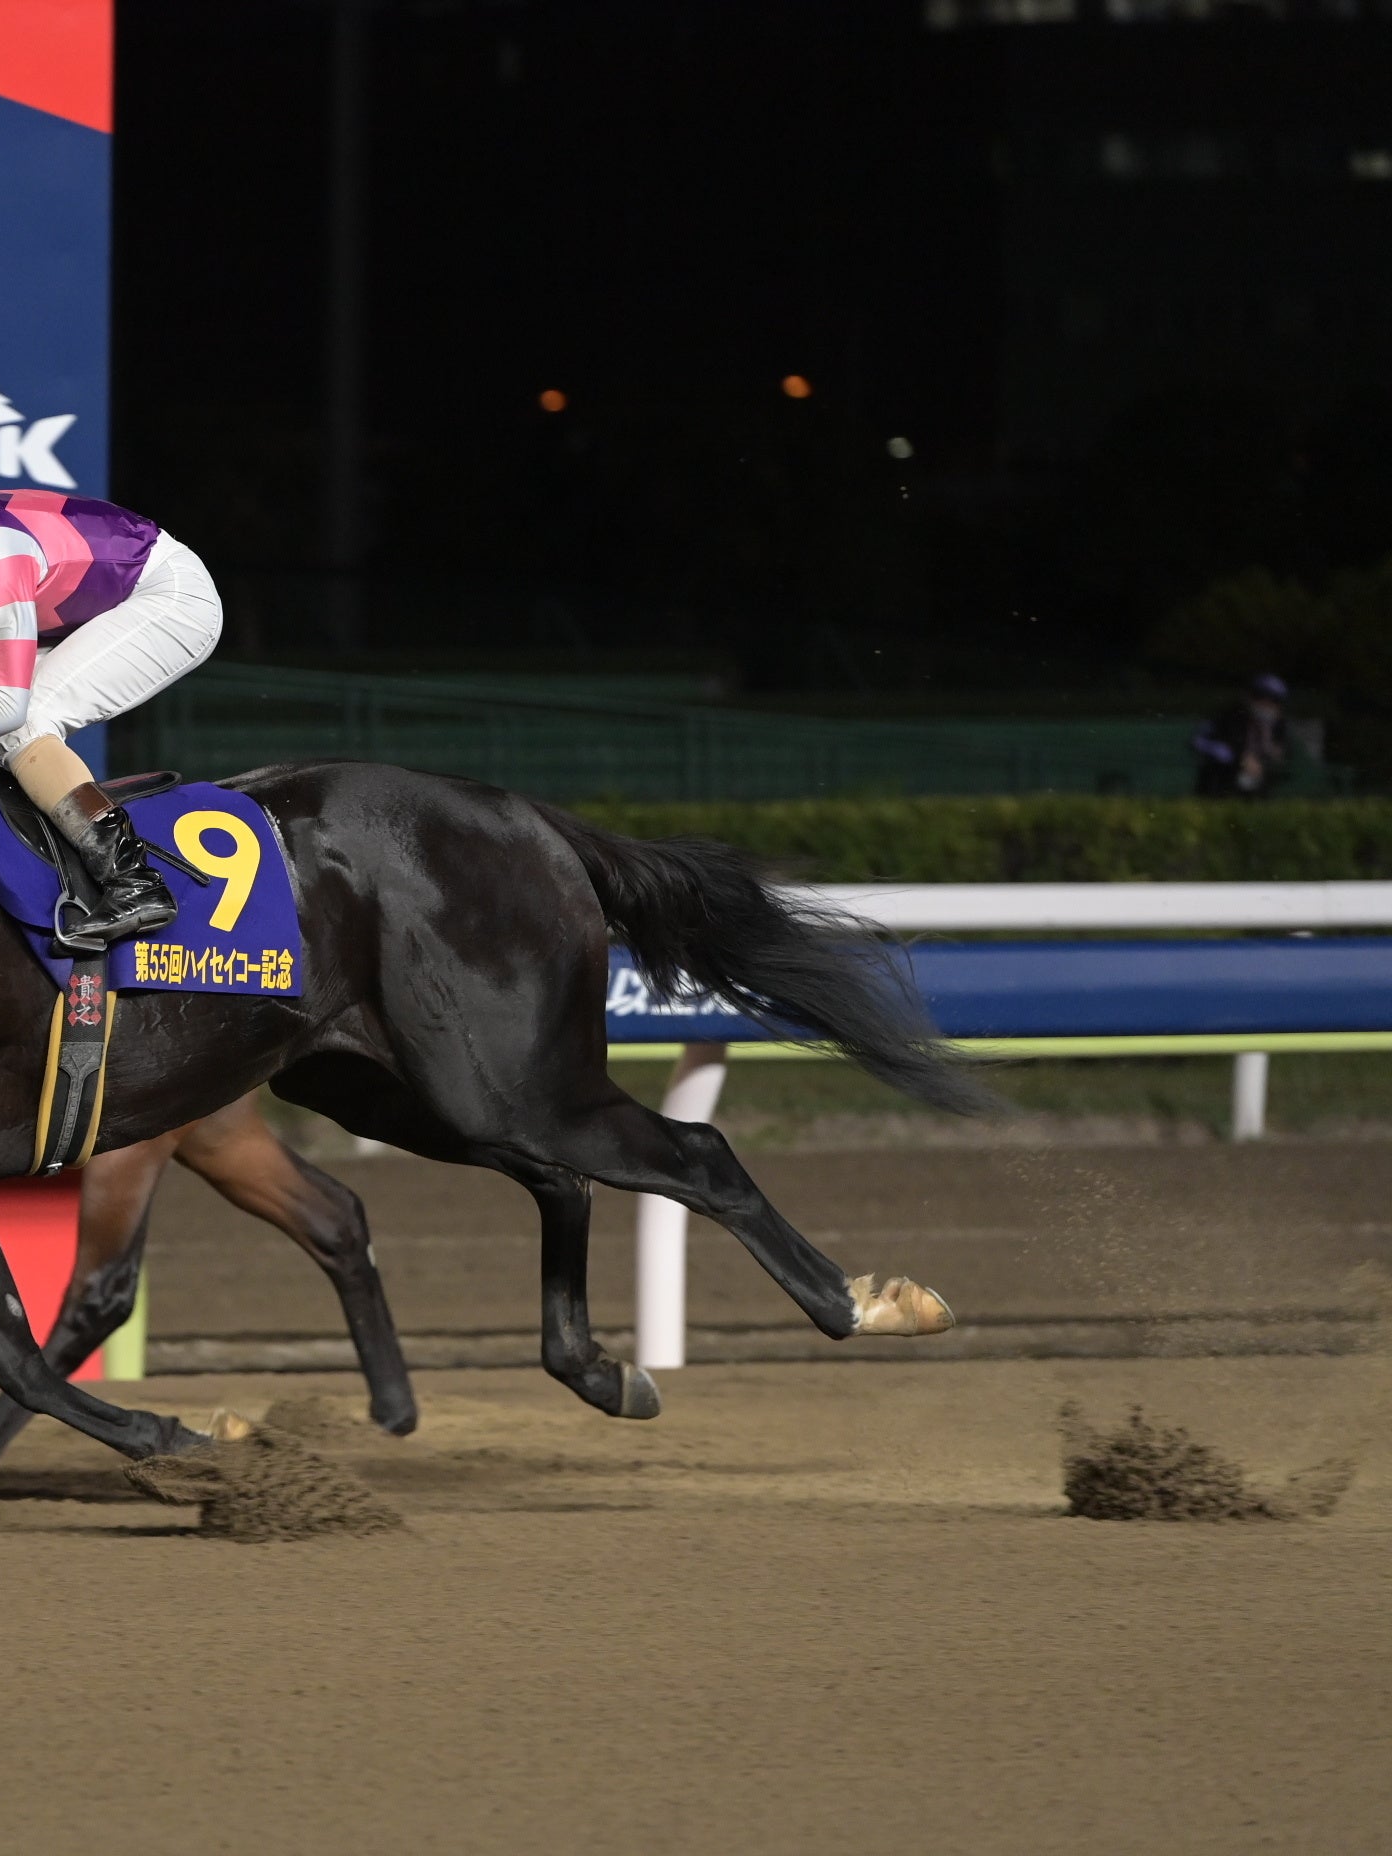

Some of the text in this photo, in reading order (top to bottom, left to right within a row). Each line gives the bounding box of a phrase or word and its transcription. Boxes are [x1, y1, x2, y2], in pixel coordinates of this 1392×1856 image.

[172, 810, 261, 932] 9
[134, 941, 294, 990] 第55回ハイセイコー記念
[75, 974, 95, 1025] 貴之
